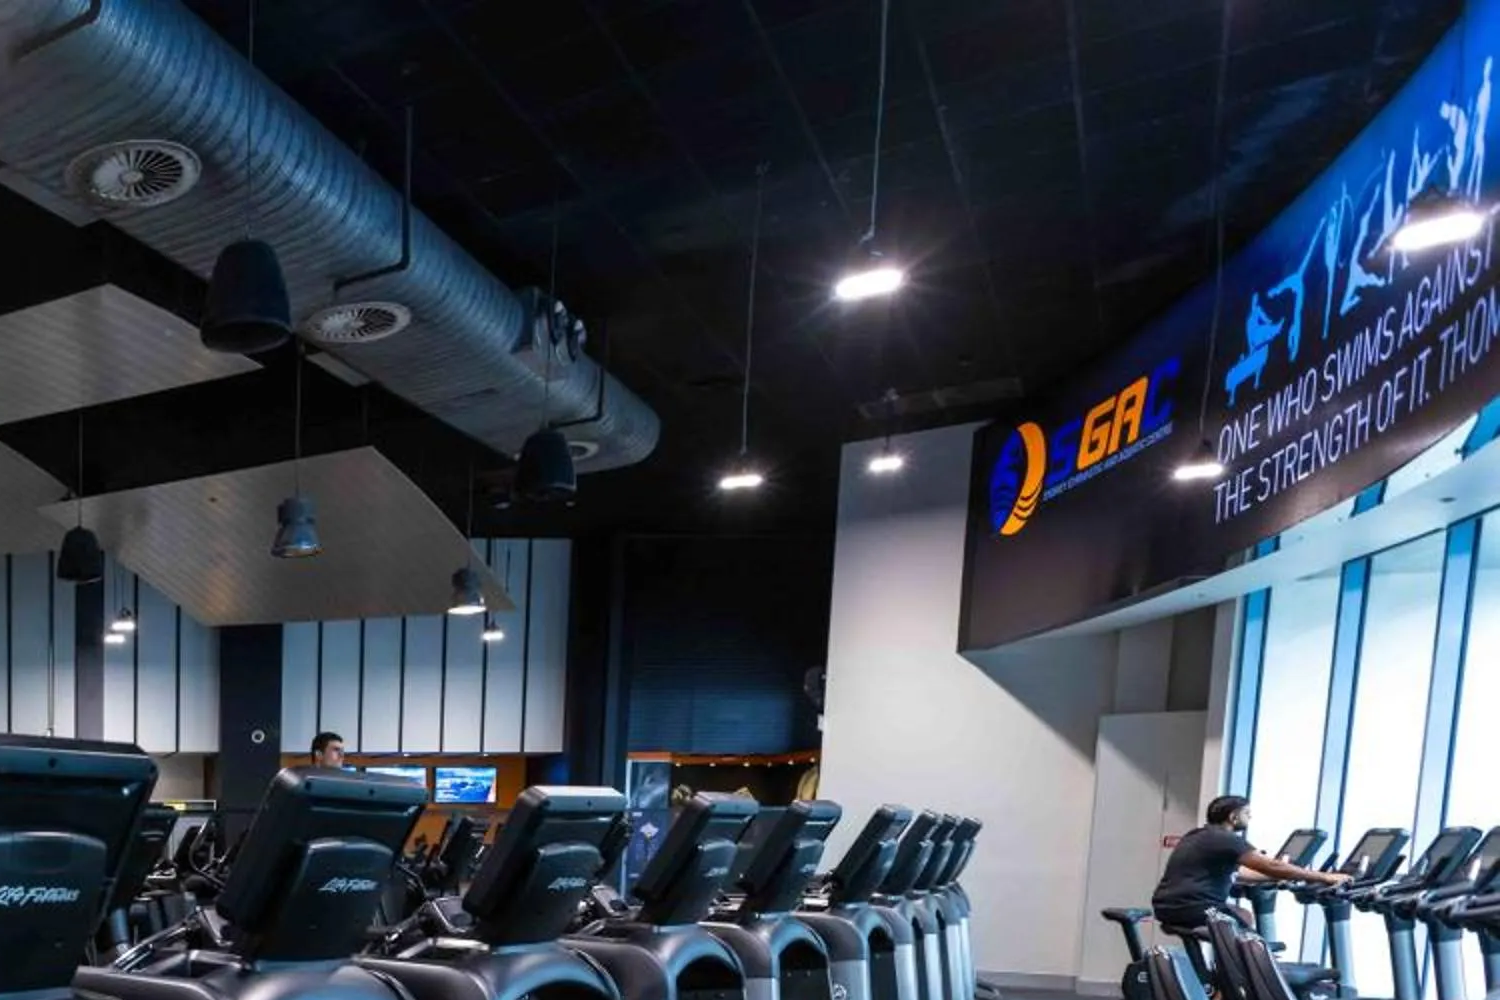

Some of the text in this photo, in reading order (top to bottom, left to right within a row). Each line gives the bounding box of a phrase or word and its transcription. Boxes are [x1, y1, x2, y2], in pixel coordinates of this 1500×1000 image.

[1045, 356, 1181, 487] SGAC
[1214, 467, 1255, 524] THE
[1257, 393, 1373, 502] STRENGTH
[1375, 366, 1408, 432] OF
[1409, 345, 1432, 412] IT.
[1217, 404, 1264, 466] ONE
[1267, 368, 1317, 437] WHO
[1321, 305, 1396, 402] SWIMS
